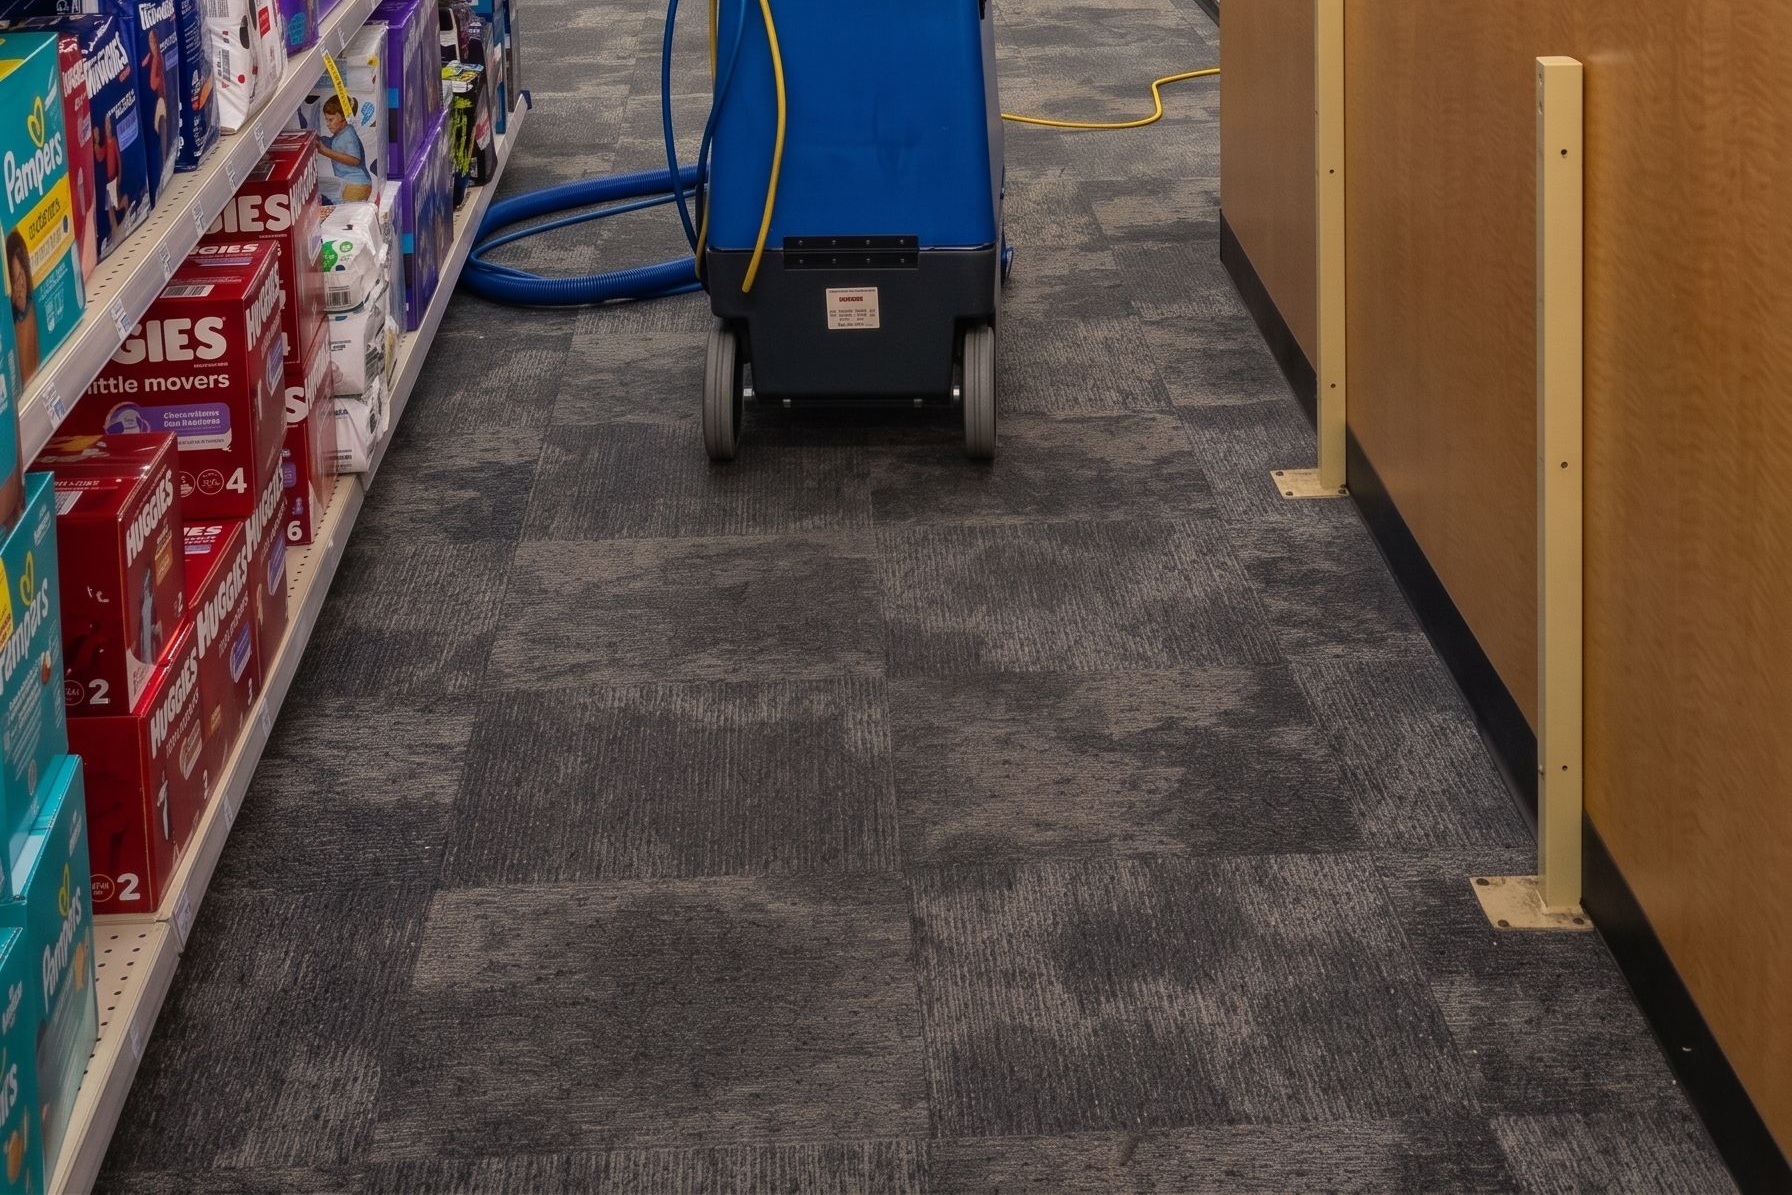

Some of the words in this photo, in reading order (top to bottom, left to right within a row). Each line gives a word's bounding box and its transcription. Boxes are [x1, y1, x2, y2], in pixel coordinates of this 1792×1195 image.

[4, 131, 63, 214] Pampers
[144, 374, 230, 392] movers
[225, 467, 248, 494] 4
[126, 468, 174, 568] HUGGIES
[287, 520, 303, 541] 6
[197, 545, 247, 660] HUGGIES
[88, 678, 110, 705] 2
[150, 655, 198, 759] HUGGIES
[117, 873, 141, 901] 2
[43, 886, 82, 1013] Pampers
